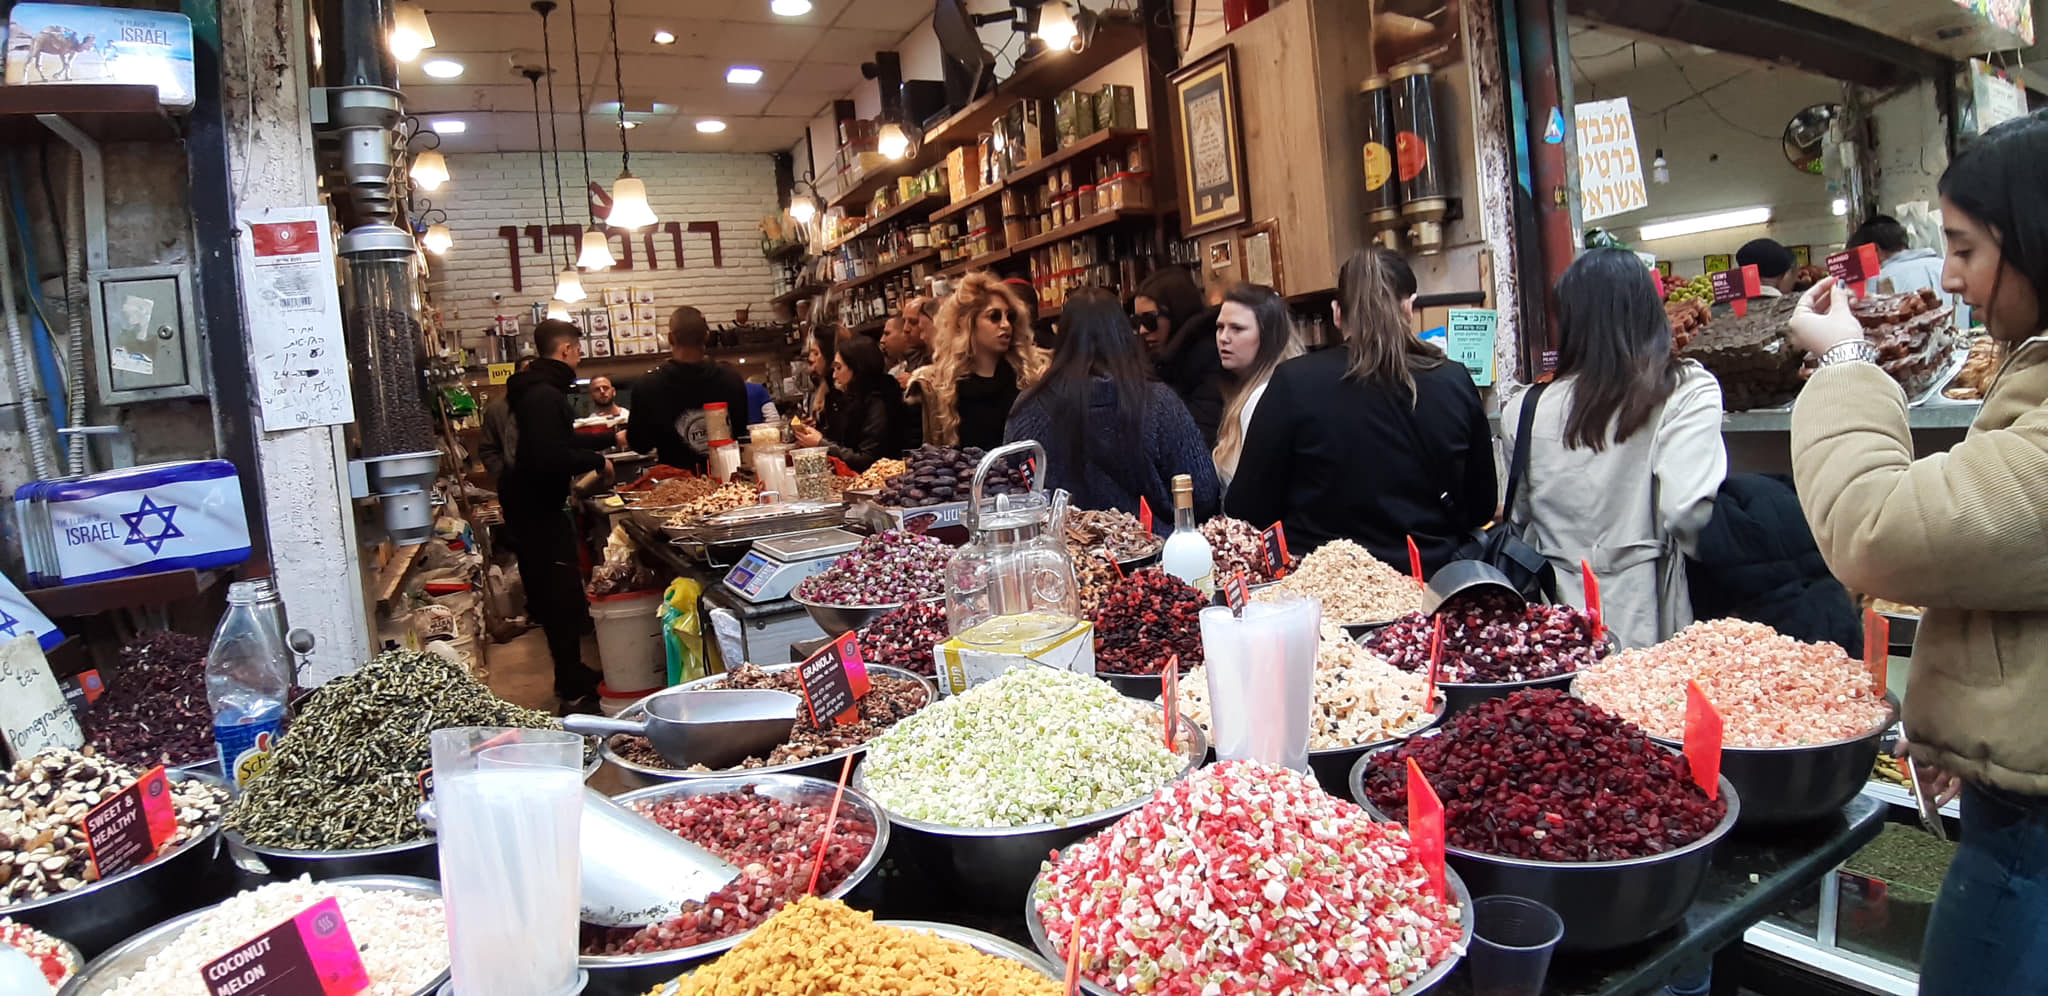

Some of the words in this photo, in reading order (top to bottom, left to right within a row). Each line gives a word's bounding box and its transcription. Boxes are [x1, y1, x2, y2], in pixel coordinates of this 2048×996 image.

[121, 27, 172, 46] ISRAEL
[65, 521, 120, 547] ISRAEL
[802, 652, 835, 680] GRANOLA
[87, 800, 122, 833] SWEET
[124, 794, 134, 808] &
[91, 808, 137, 849] HEALTHY
[208, 936, 272, 981] COCONUT
[216, 964, 266, 996] MELON
